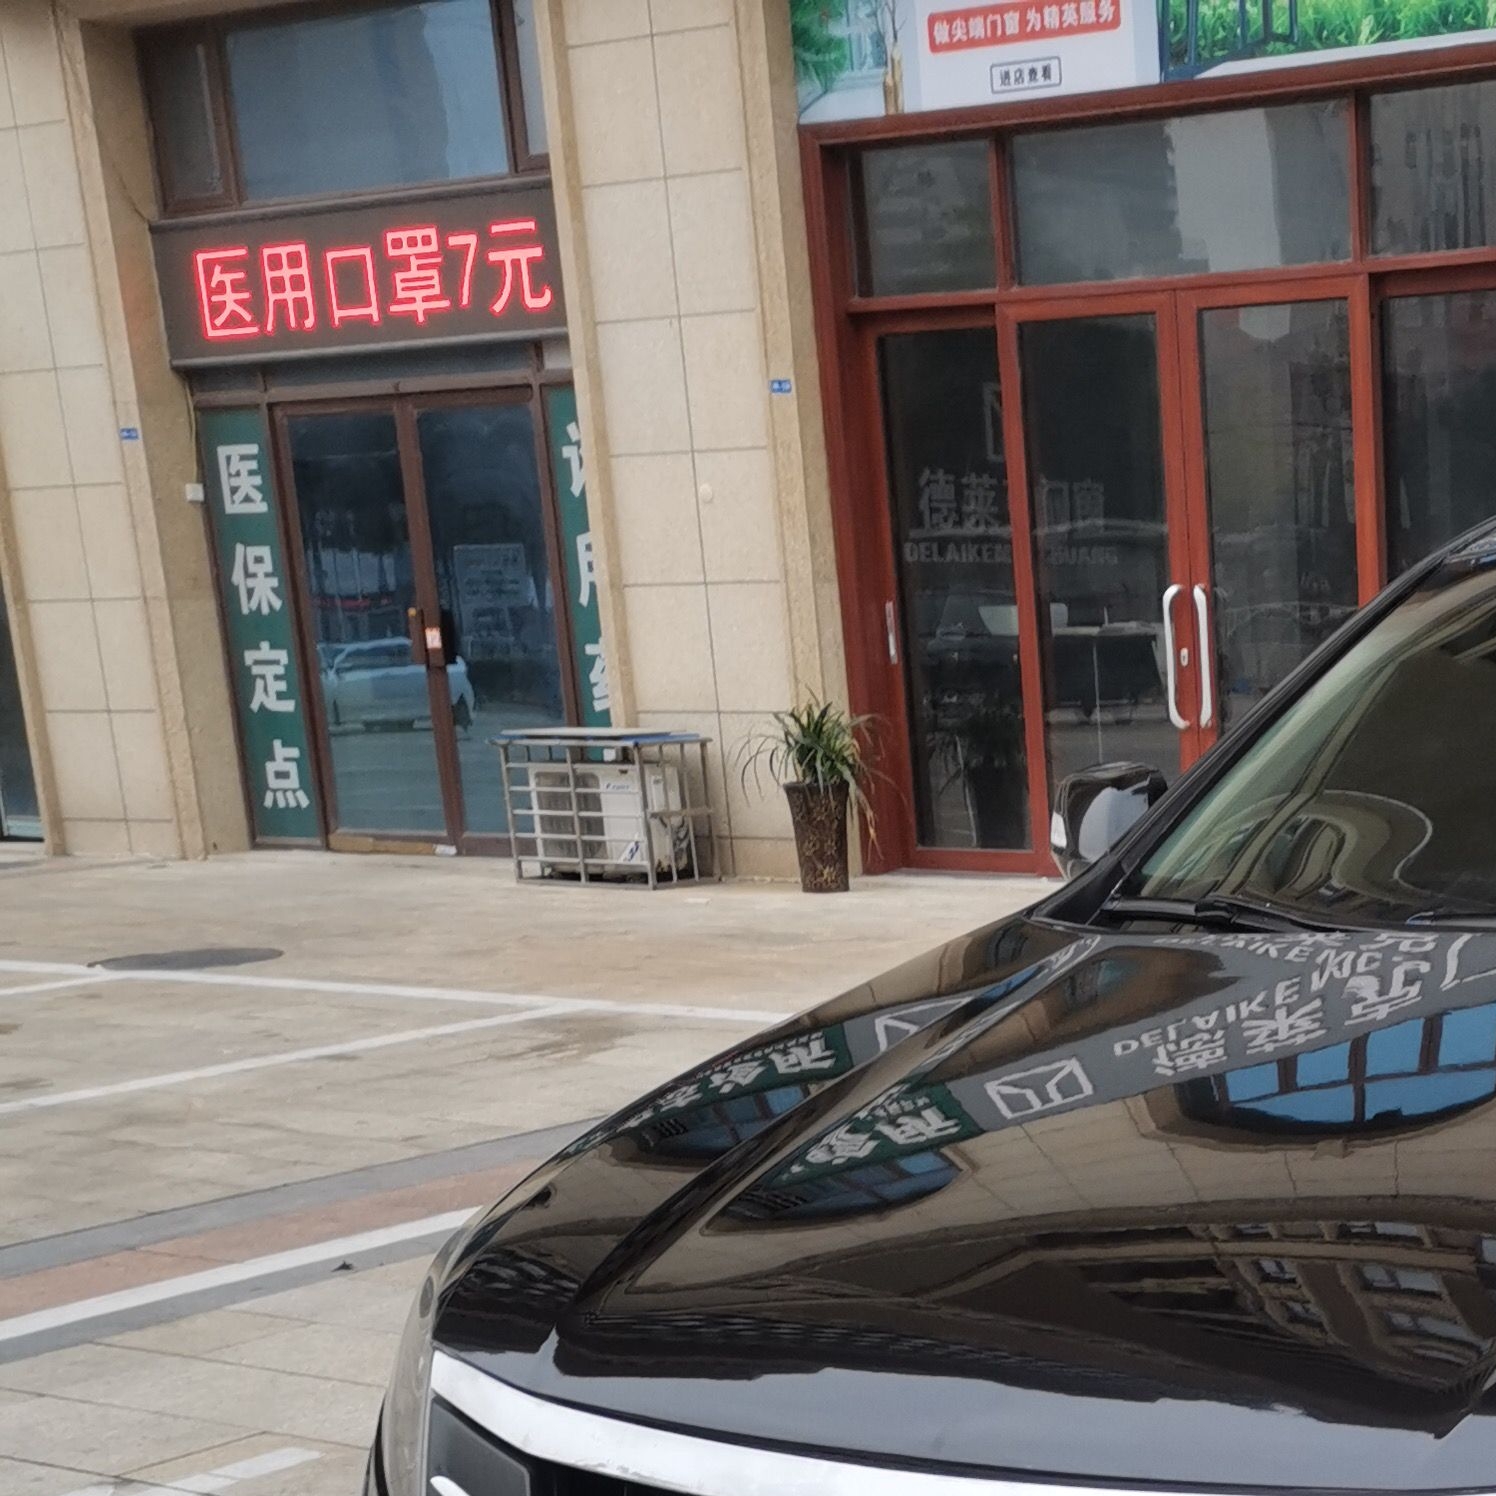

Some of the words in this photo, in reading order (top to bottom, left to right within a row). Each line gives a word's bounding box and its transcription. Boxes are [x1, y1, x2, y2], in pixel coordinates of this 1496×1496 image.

[195, 218, 552, 339] 医用口罩7元
[216, 443, 310, 810] 医保定点
